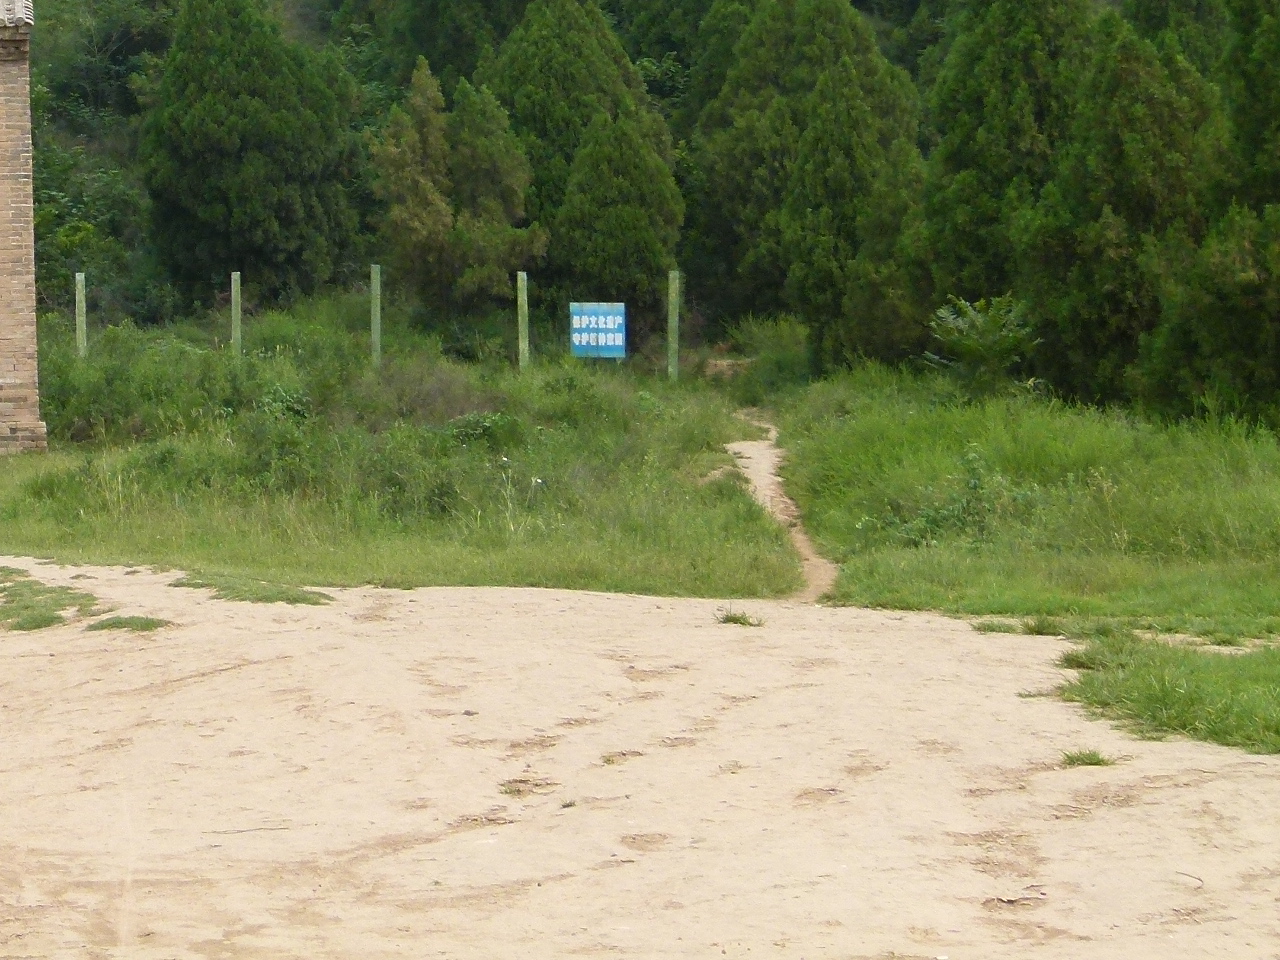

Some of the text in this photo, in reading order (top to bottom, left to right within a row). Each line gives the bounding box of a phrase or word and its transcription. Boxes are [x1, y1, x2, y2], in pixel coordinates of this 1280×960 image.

[572, 315, 623, 329] 保护文化遗产
[572, 332, 623, 346] 守护精神家园
